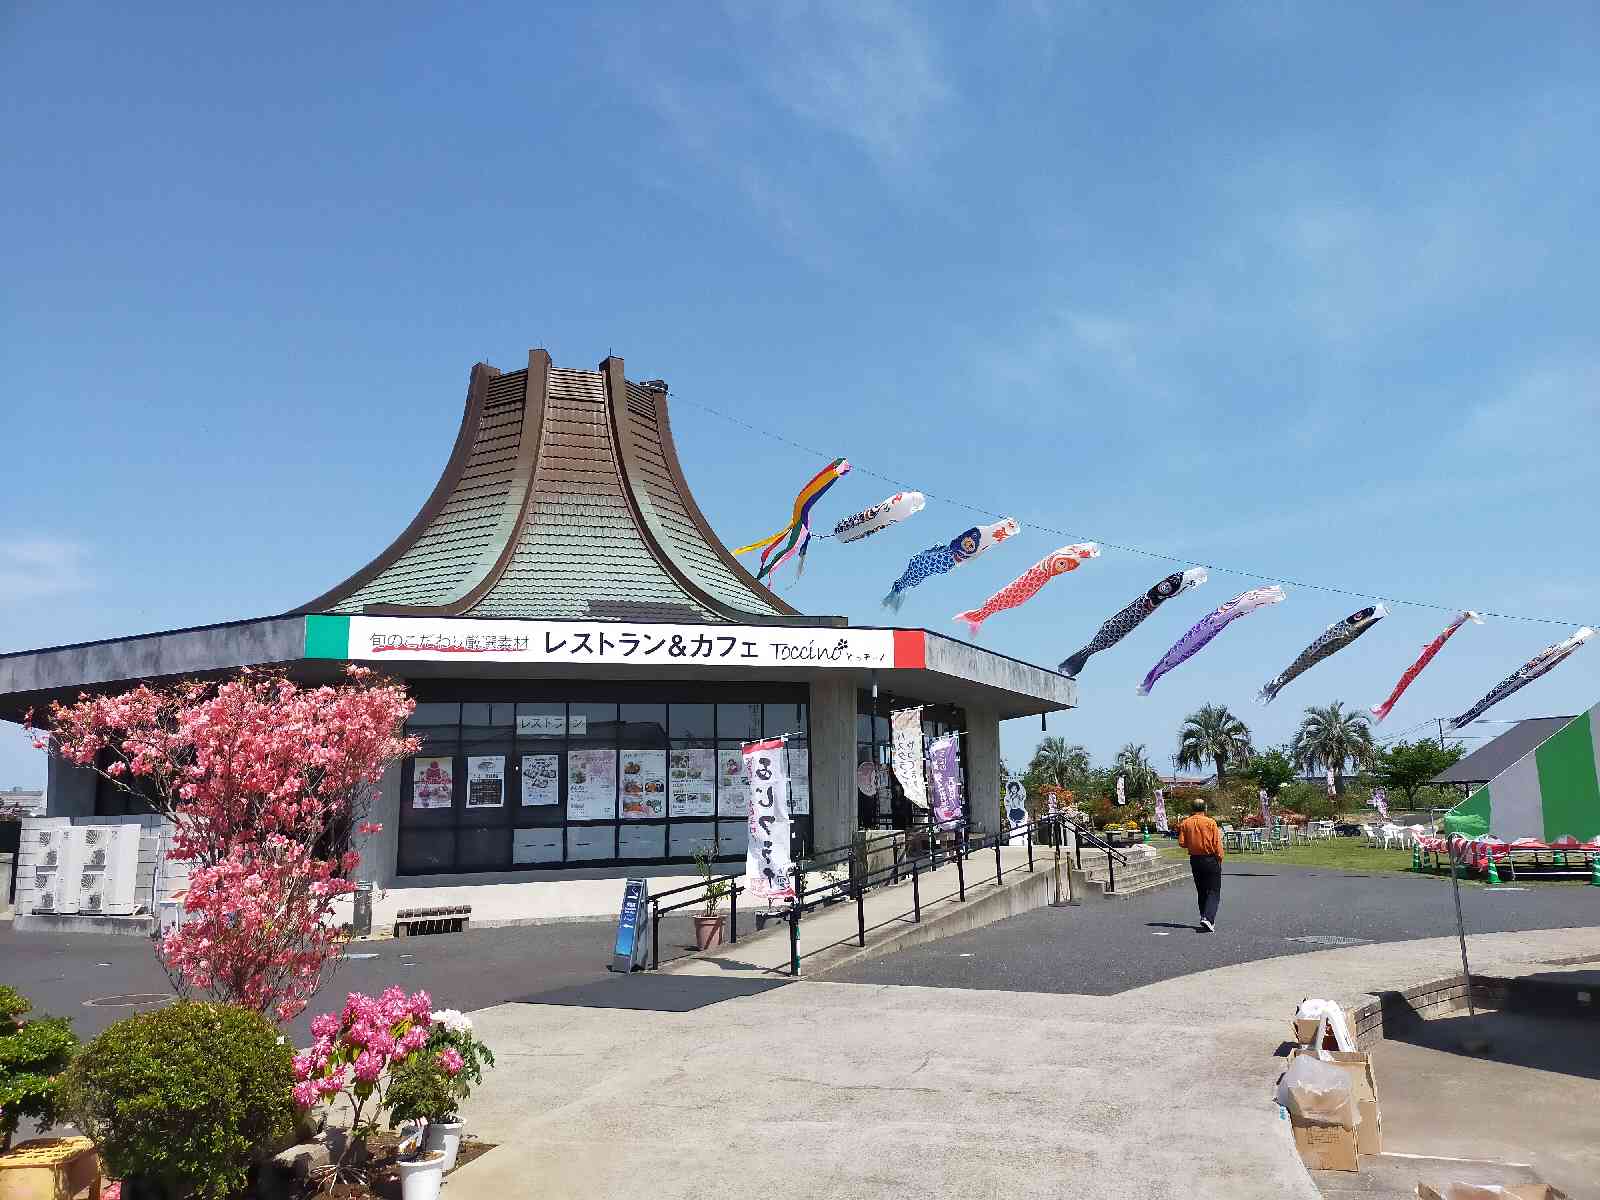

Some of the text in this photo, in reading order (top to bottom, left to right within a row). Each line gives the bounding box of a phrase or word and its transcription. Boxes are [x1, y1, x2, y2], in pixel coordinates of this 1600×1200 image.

[369, 632, 530, 650] 旬のこだわり厳選素材
[544, 631, 759, 658] レストラン&カフェ
[769, 639, 842, 661] Toccino
[520, 717, 585, 730] レストラン
